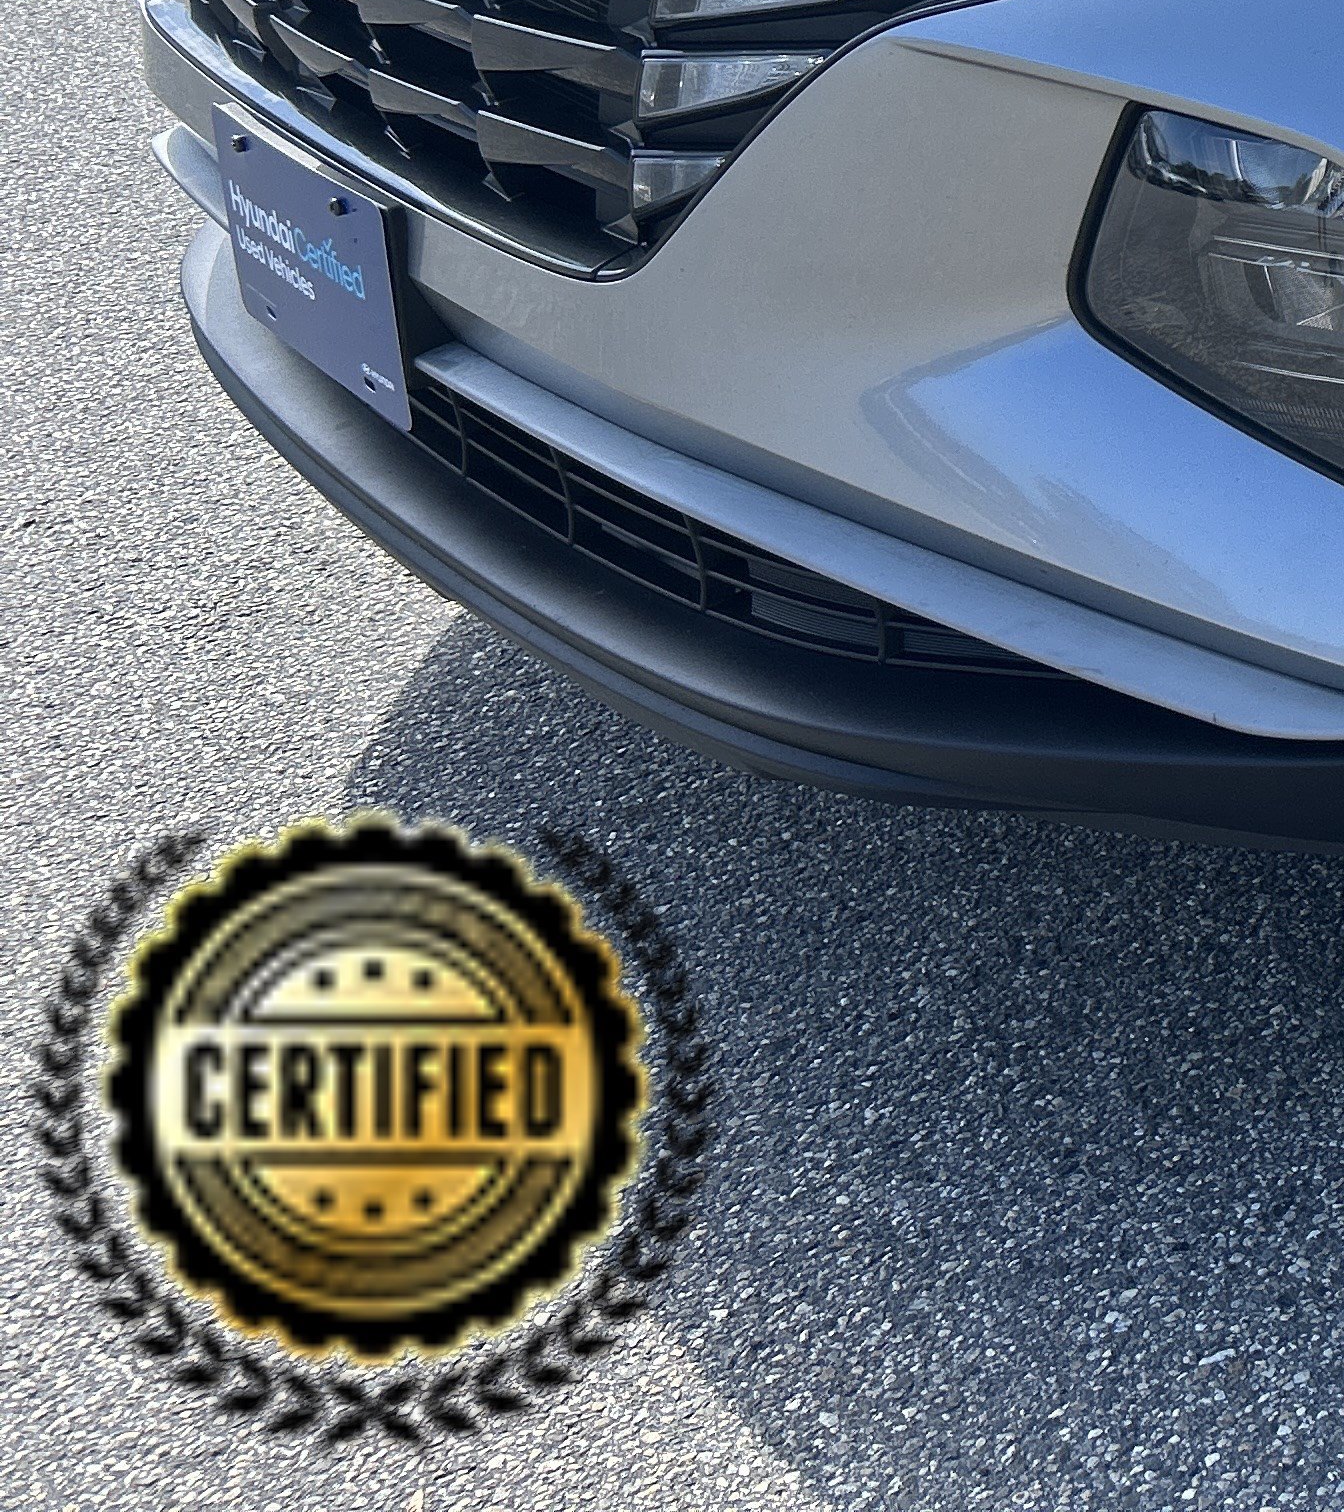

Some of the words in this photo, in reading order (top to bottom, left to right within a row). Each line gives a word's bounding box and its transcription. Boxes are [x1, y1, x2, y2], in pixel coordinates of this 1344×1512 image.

[229, 179, 296, 254] Hyundai
[293, 227, 366, 301] Certified
[235, 224, 267, 266] Used
[264, 245, 317, 301] Vehicles
